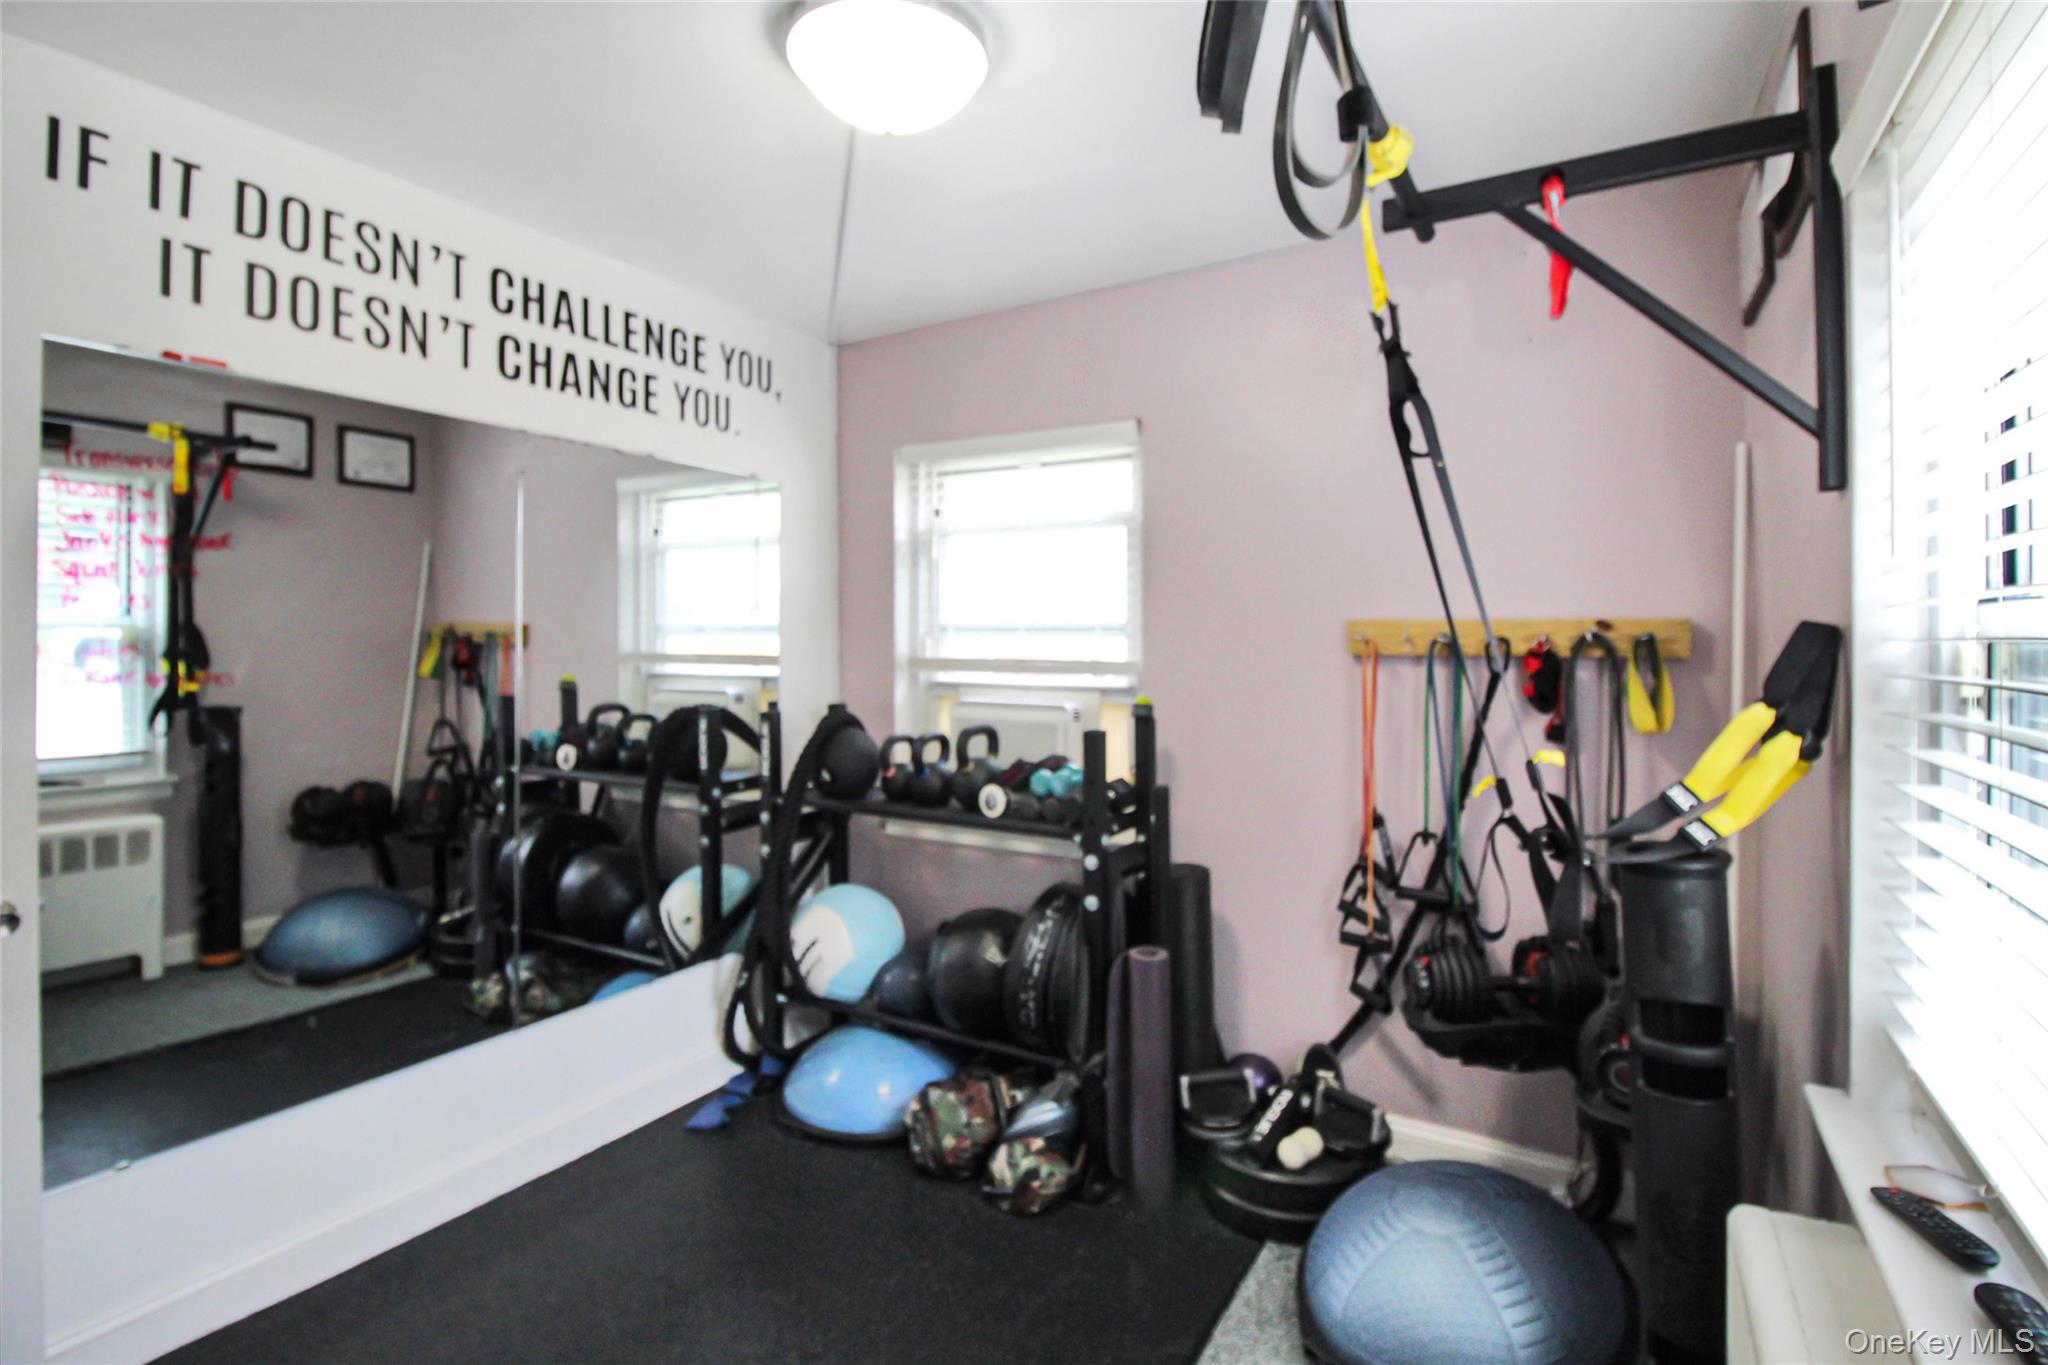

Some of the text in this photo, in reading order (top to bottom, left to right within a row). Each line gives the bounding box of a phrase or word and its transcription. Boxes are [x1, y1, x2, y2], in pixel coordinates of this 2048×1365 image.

[46, 114, 783, 401] IF IT DOESN’T CHALLENGE YOU,
[159, 238, 742, 436] IT DOESN’T CHANGE YOU.
